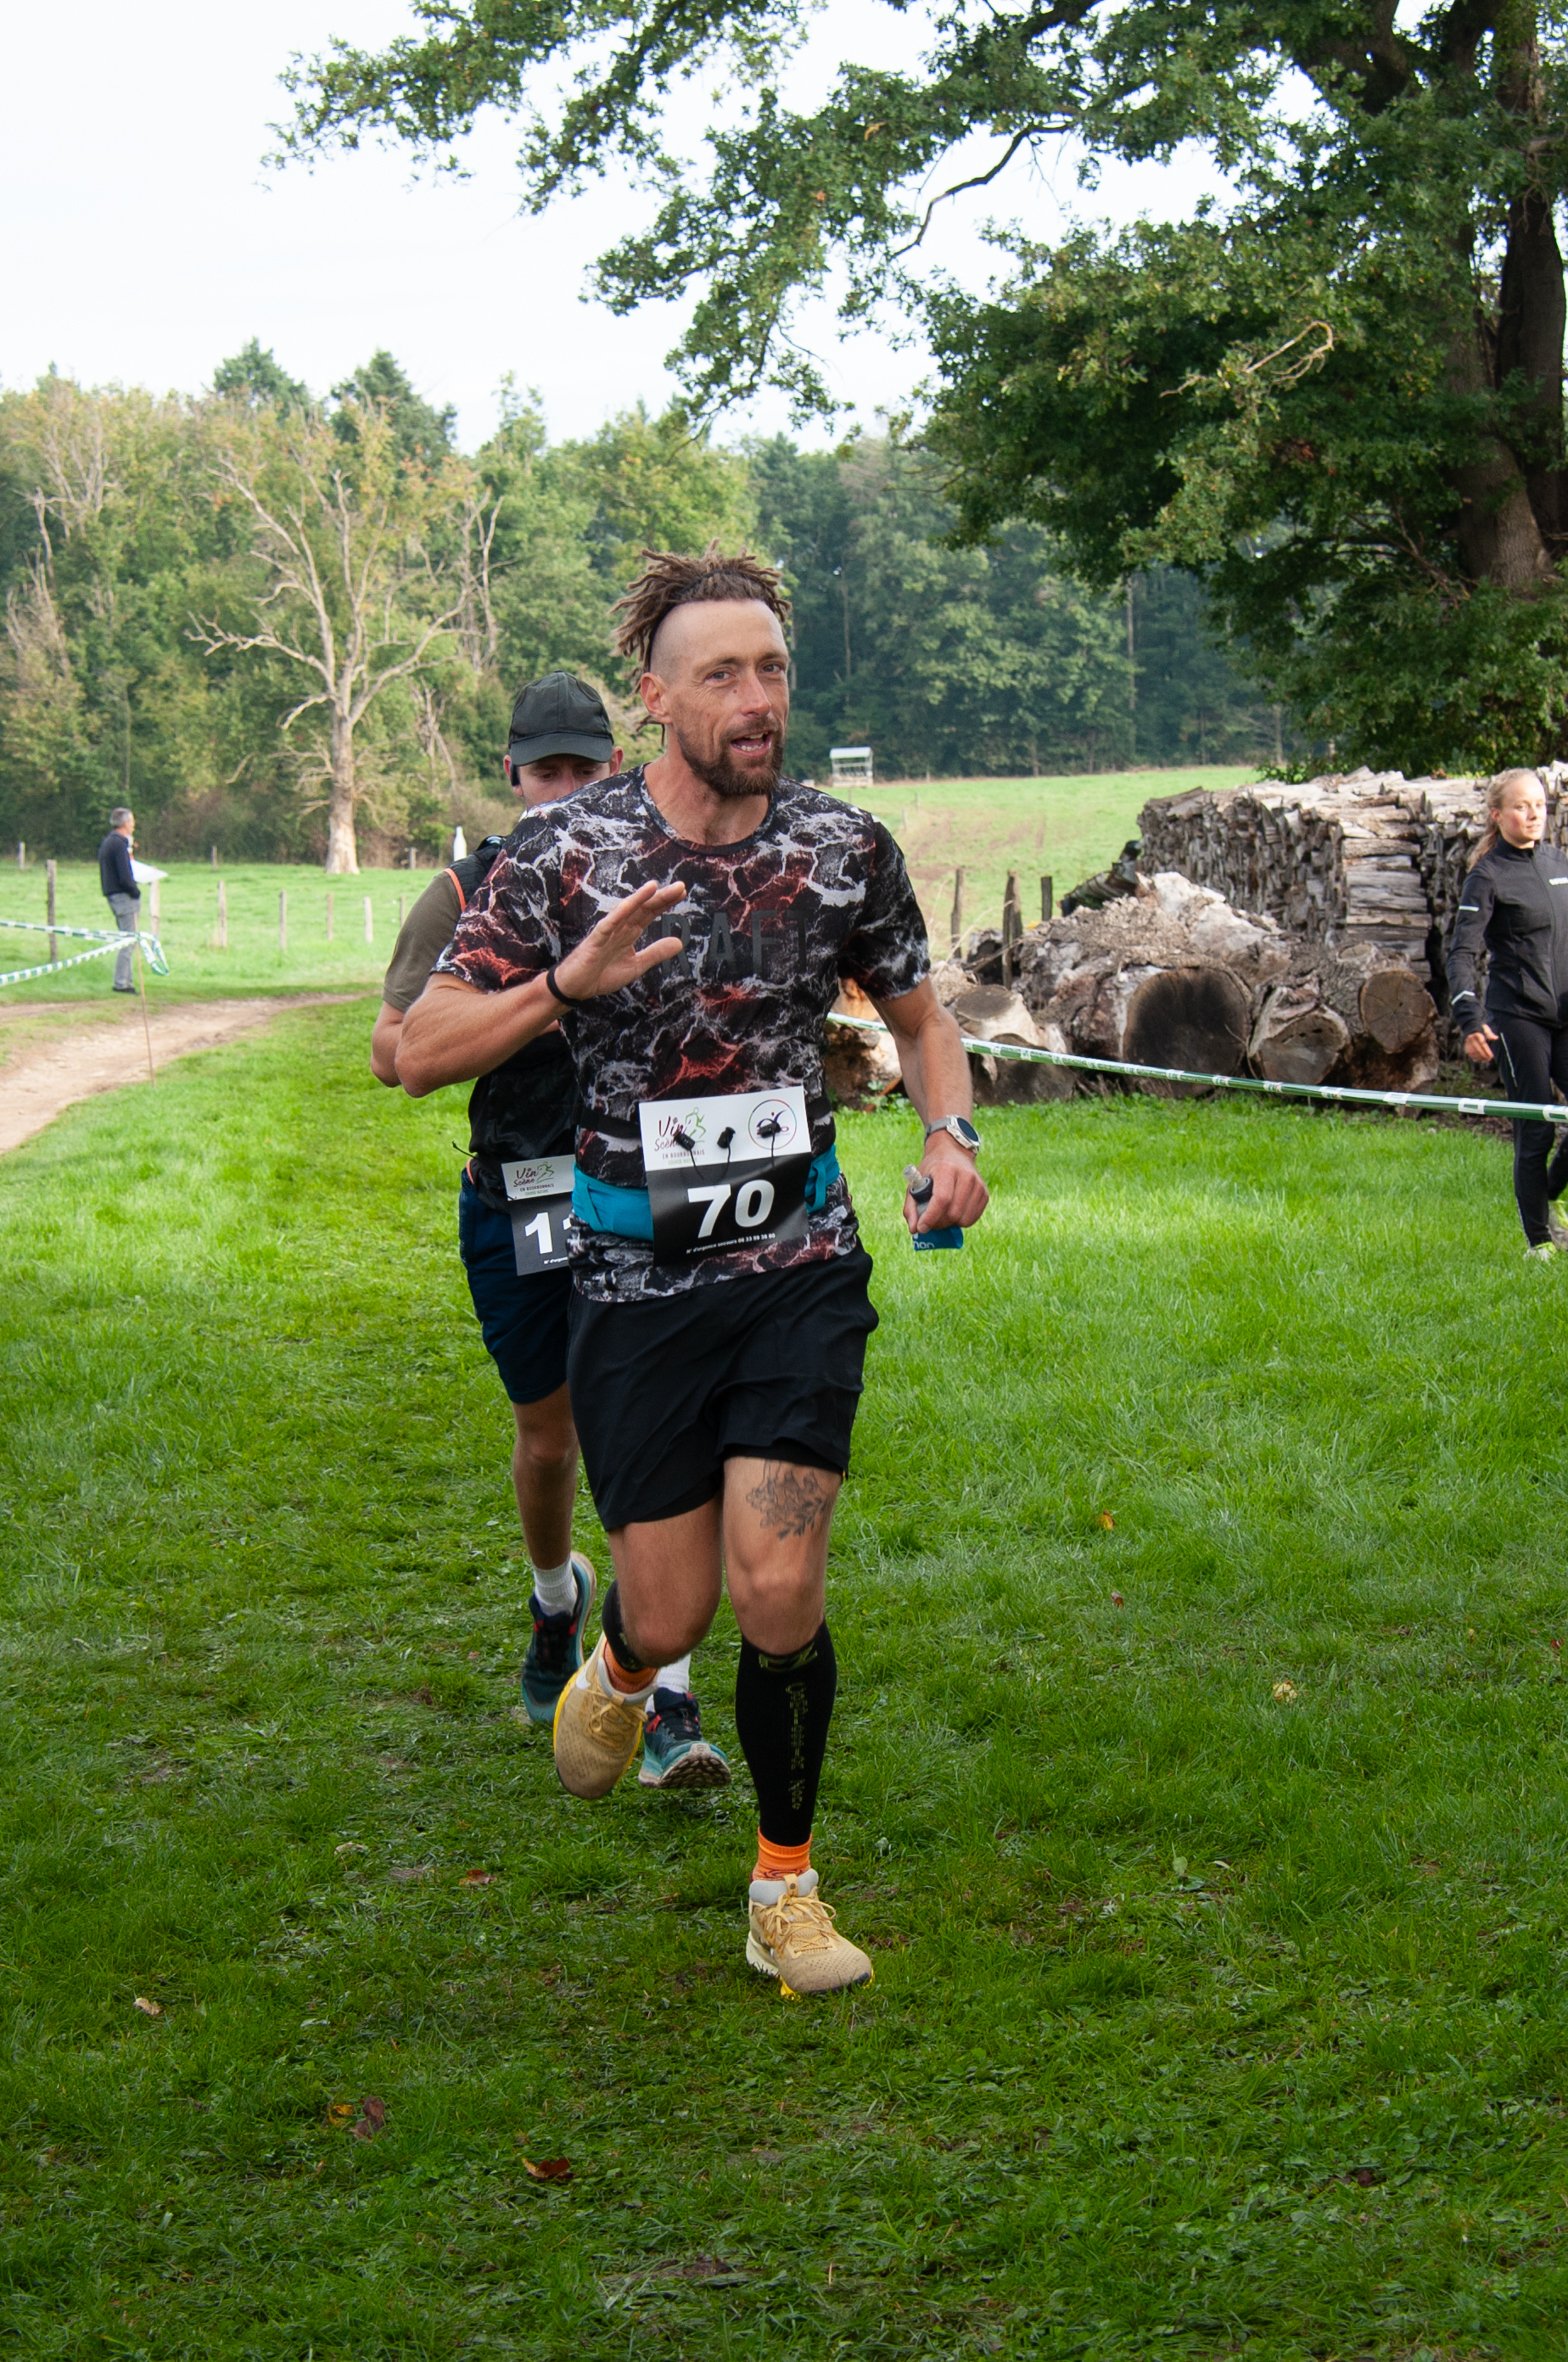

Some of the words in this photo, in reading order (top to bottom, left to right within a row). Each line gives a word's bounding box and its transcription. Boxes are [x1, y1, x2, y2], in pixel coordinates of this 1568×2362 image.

[644, 908, 810, 978] RAFT
[525, 1212, 571, 1254] 1
[687, 1179, 775, 1239] 70
